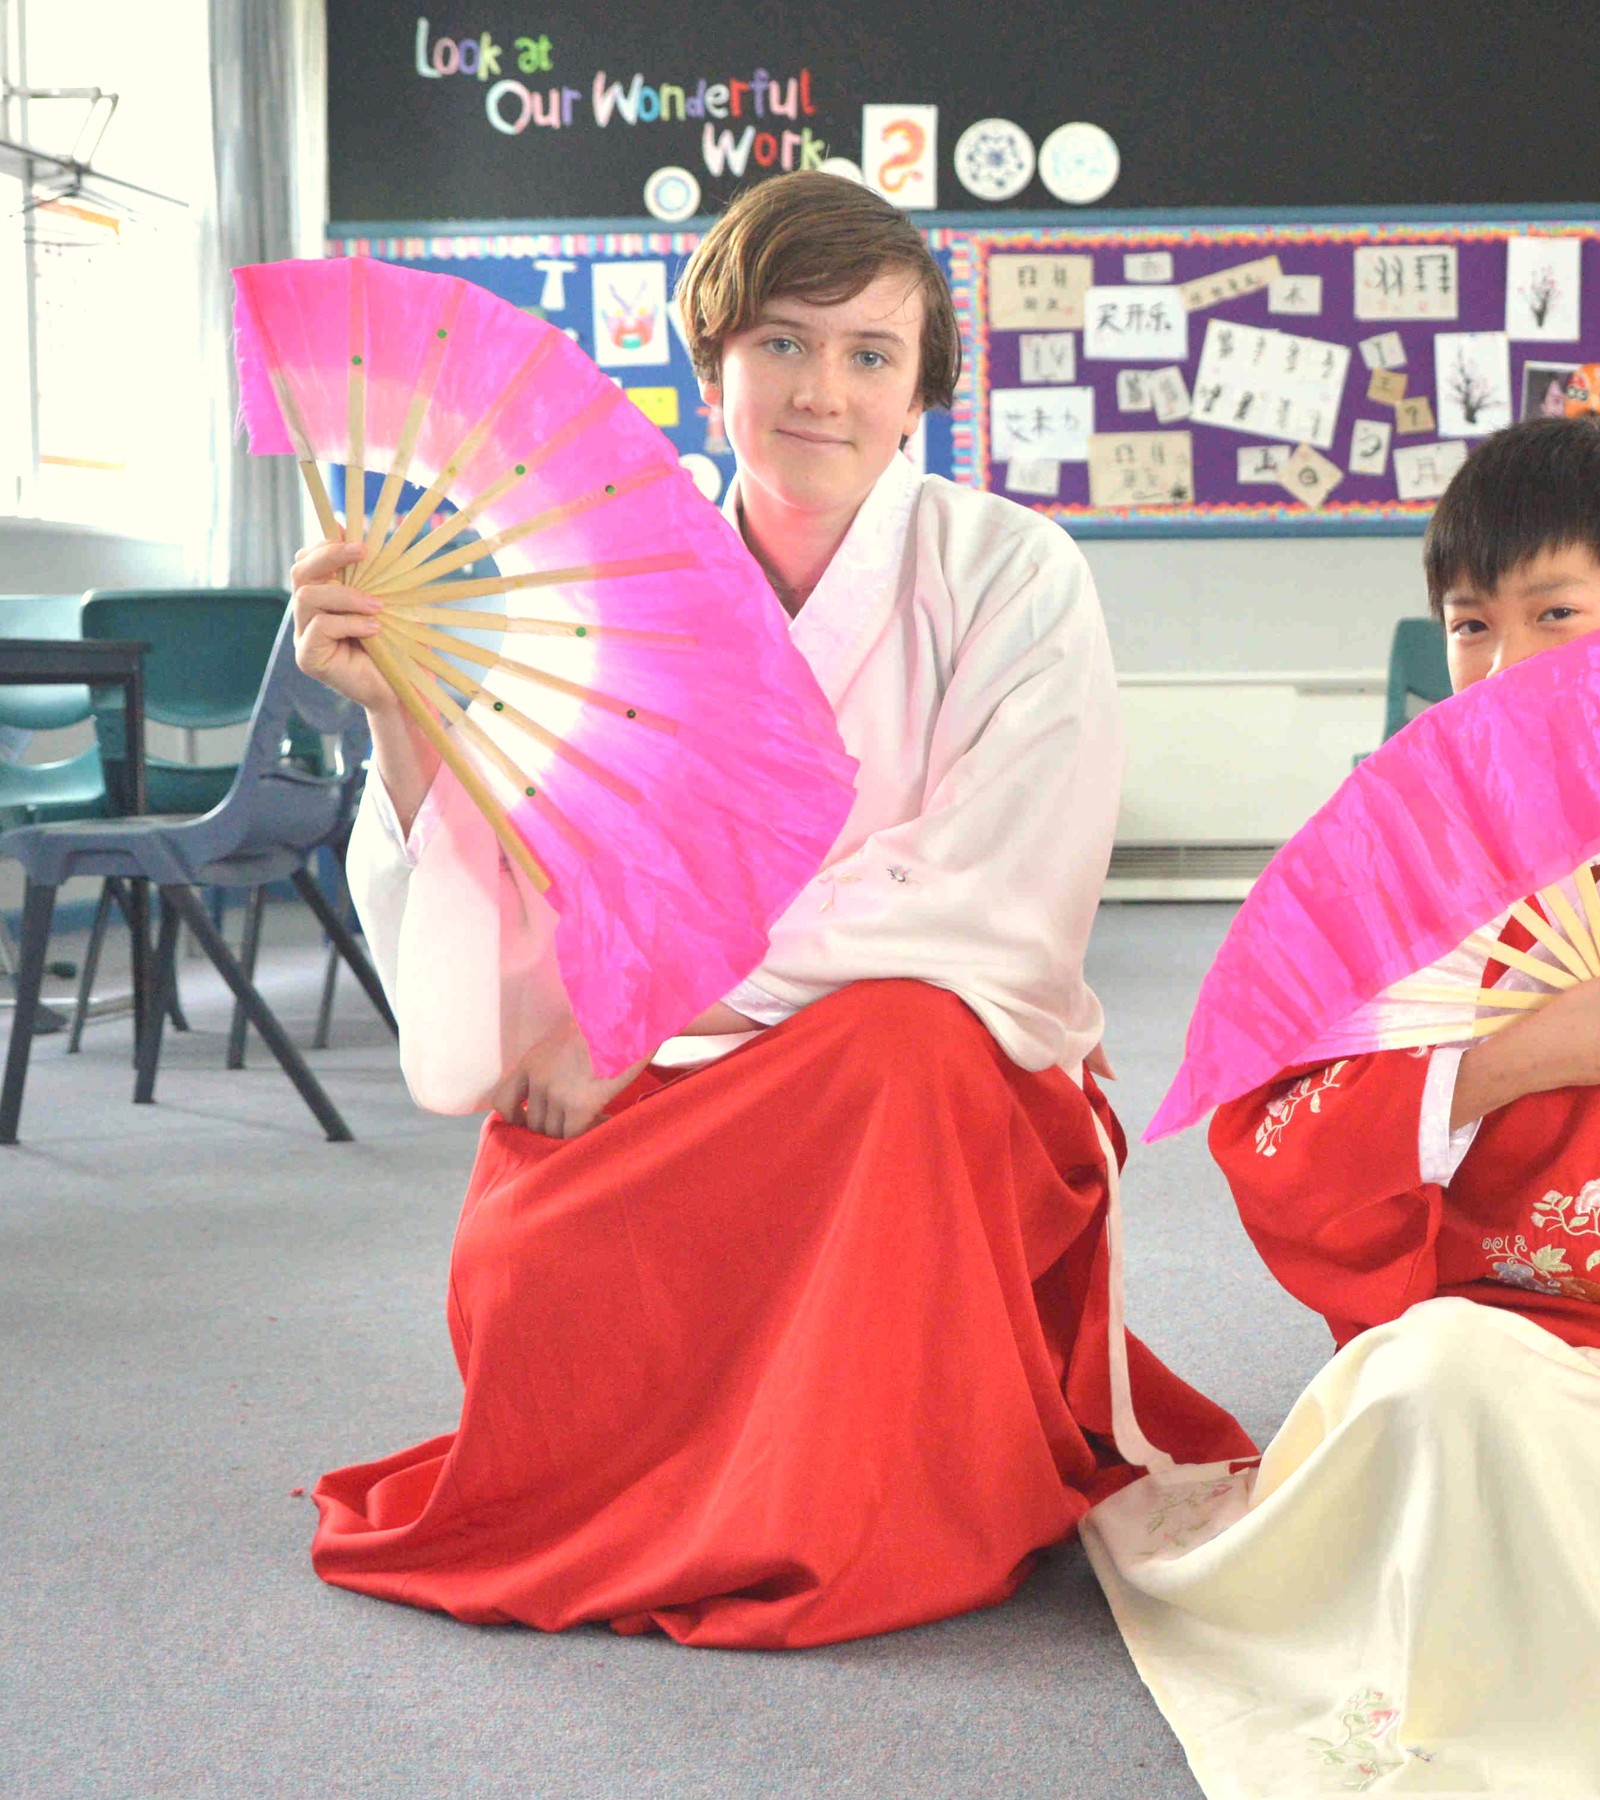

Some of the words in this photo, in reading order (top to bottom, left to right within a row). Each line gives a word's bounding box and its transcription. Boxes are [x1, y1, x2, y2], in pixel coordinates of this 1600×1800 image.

[415, 17, 502, 81] Look
[514, 34, 554, 74] at
[485, 78, 582, 136] Our
[592, 68, 816, 128] Wonderful
[702, 122, 824, 178] Work
